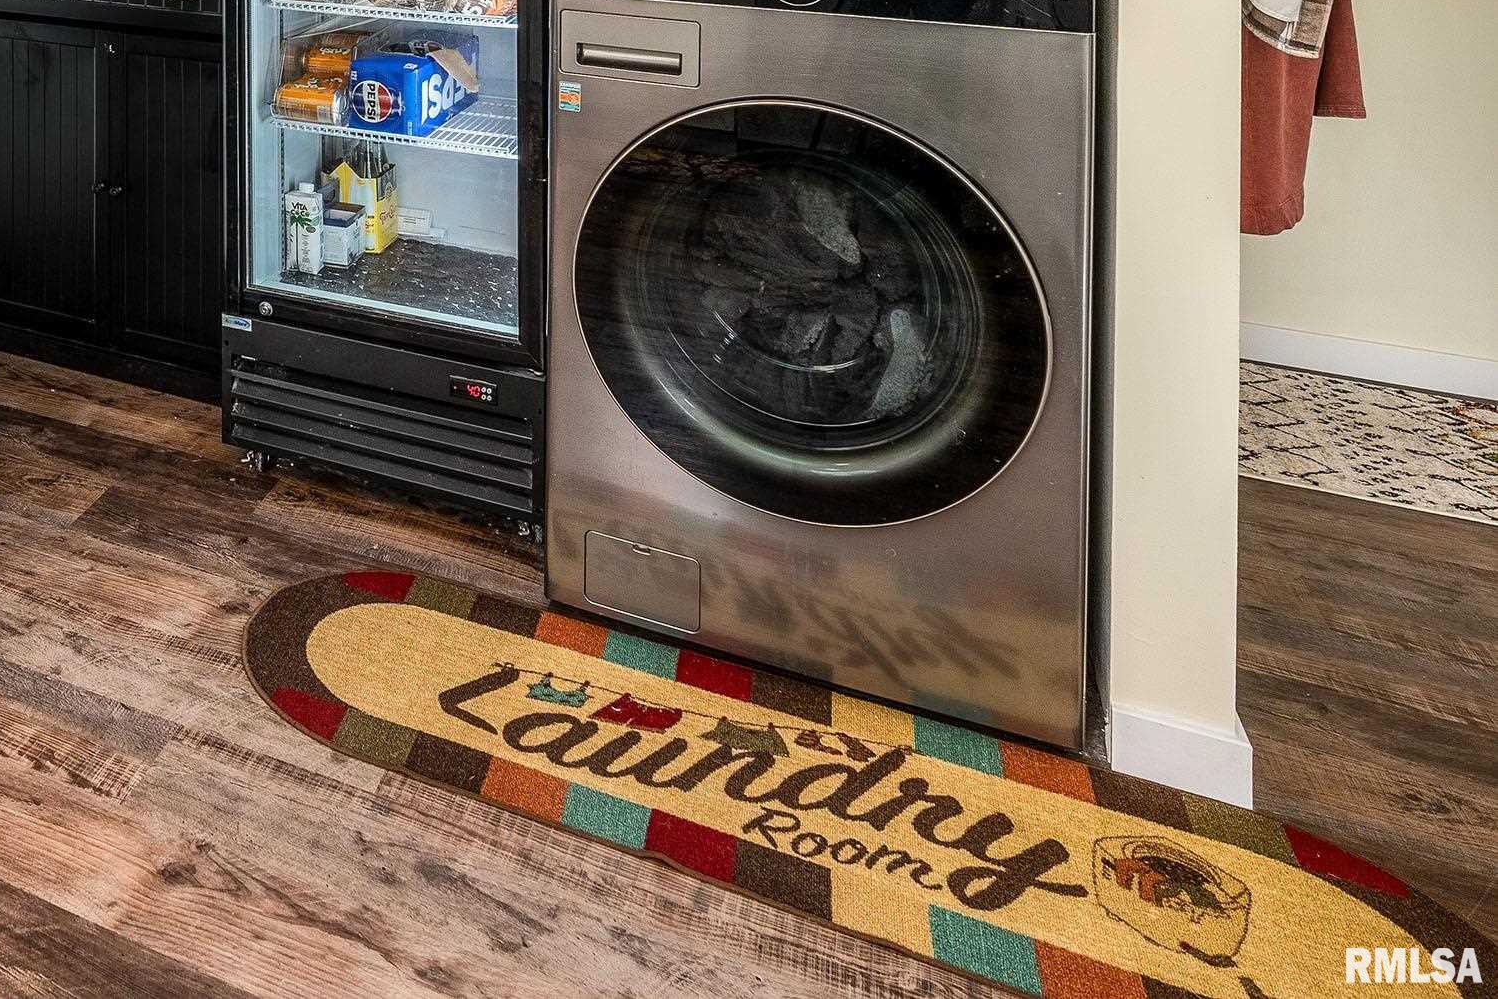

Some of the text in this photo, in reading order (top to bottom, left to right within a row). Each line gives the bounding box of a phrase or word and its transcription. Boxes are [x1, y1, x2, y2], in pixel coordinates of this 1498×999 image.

[367, 83, 376, 120] PEPSI
[439, 663, 1089, 911] Laundry
[743, 804, 944, 891] Room
